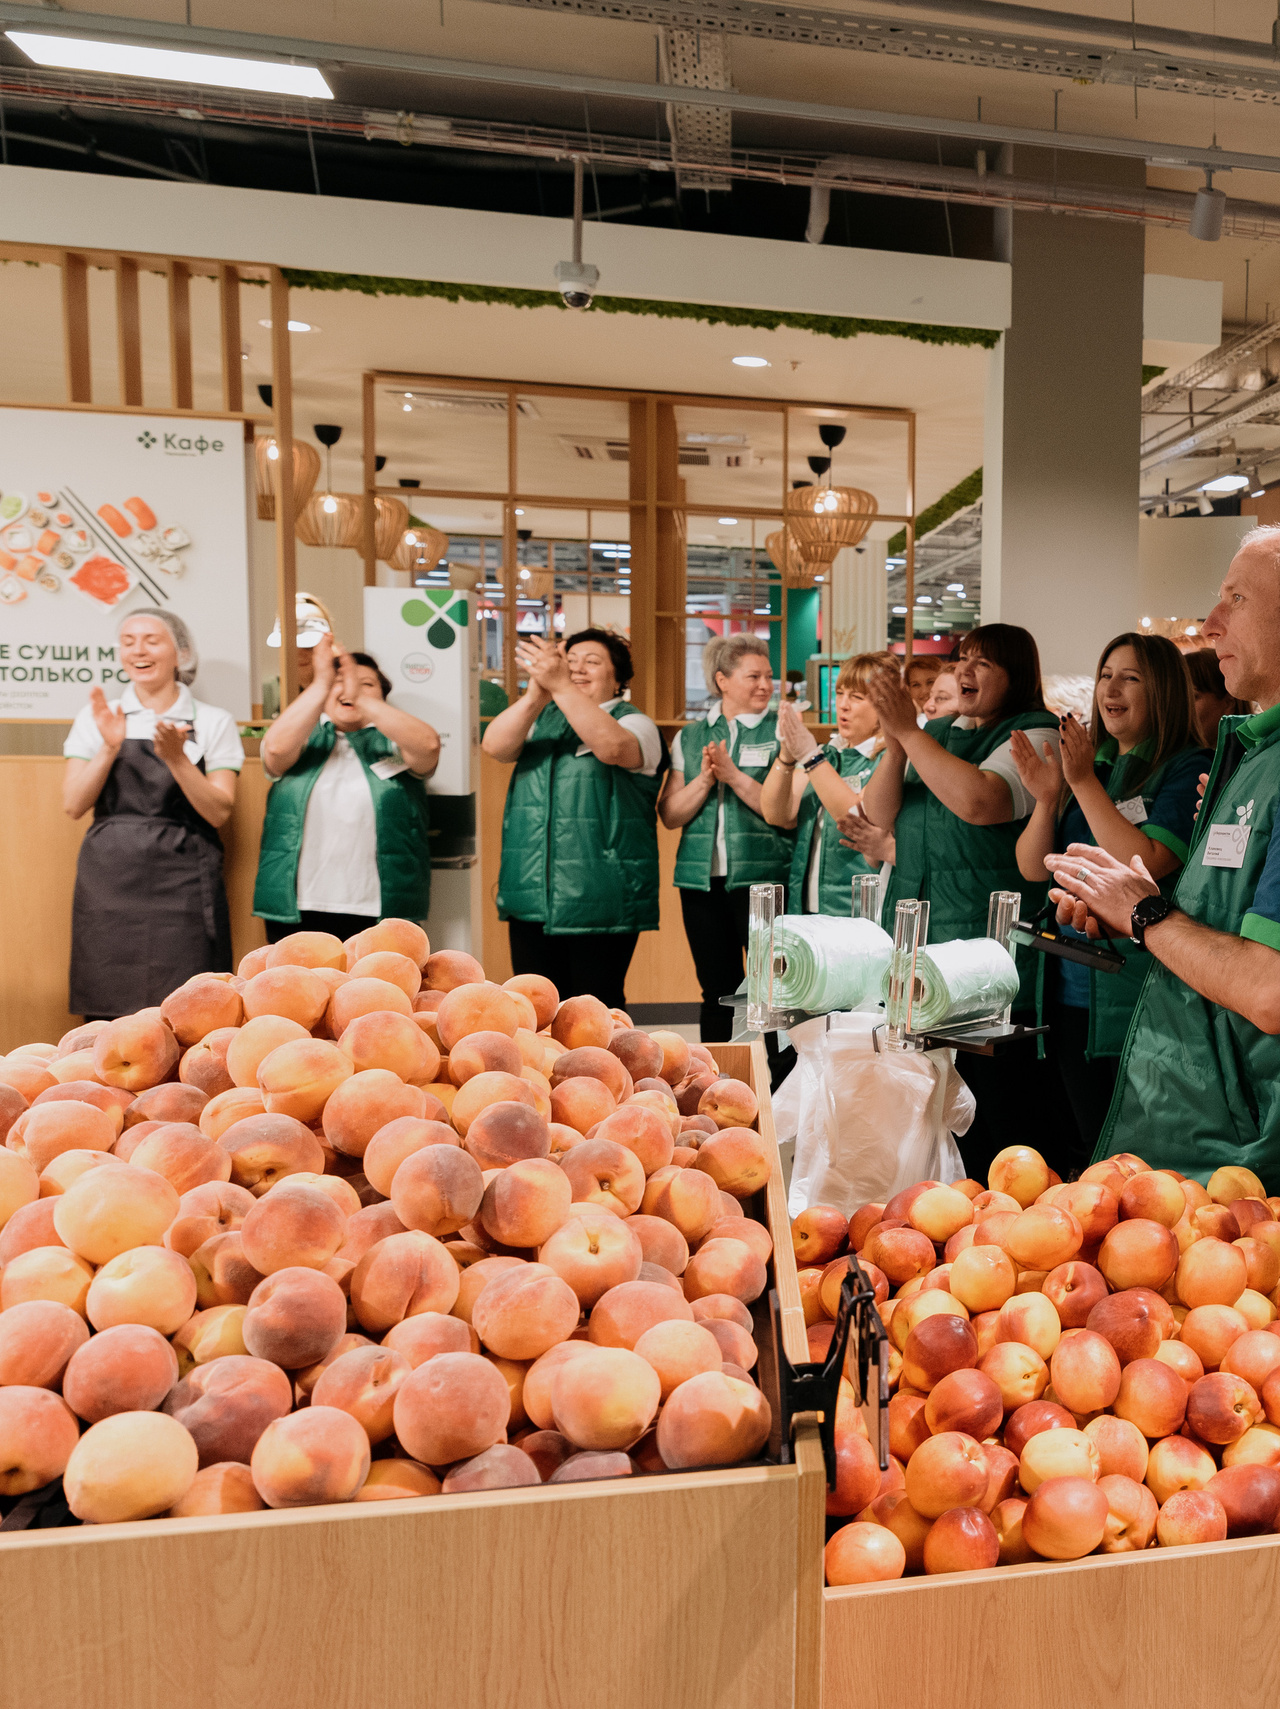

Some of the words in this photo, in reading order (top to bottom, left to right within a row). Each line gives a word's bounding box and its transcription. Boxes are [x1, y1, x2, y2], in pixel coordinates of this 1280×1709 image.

[164, 433, 224, 455] Кафе
[18, 644, 89, 662] СУШИ
[0, 666, 93, 683] ТОЛЬКО
